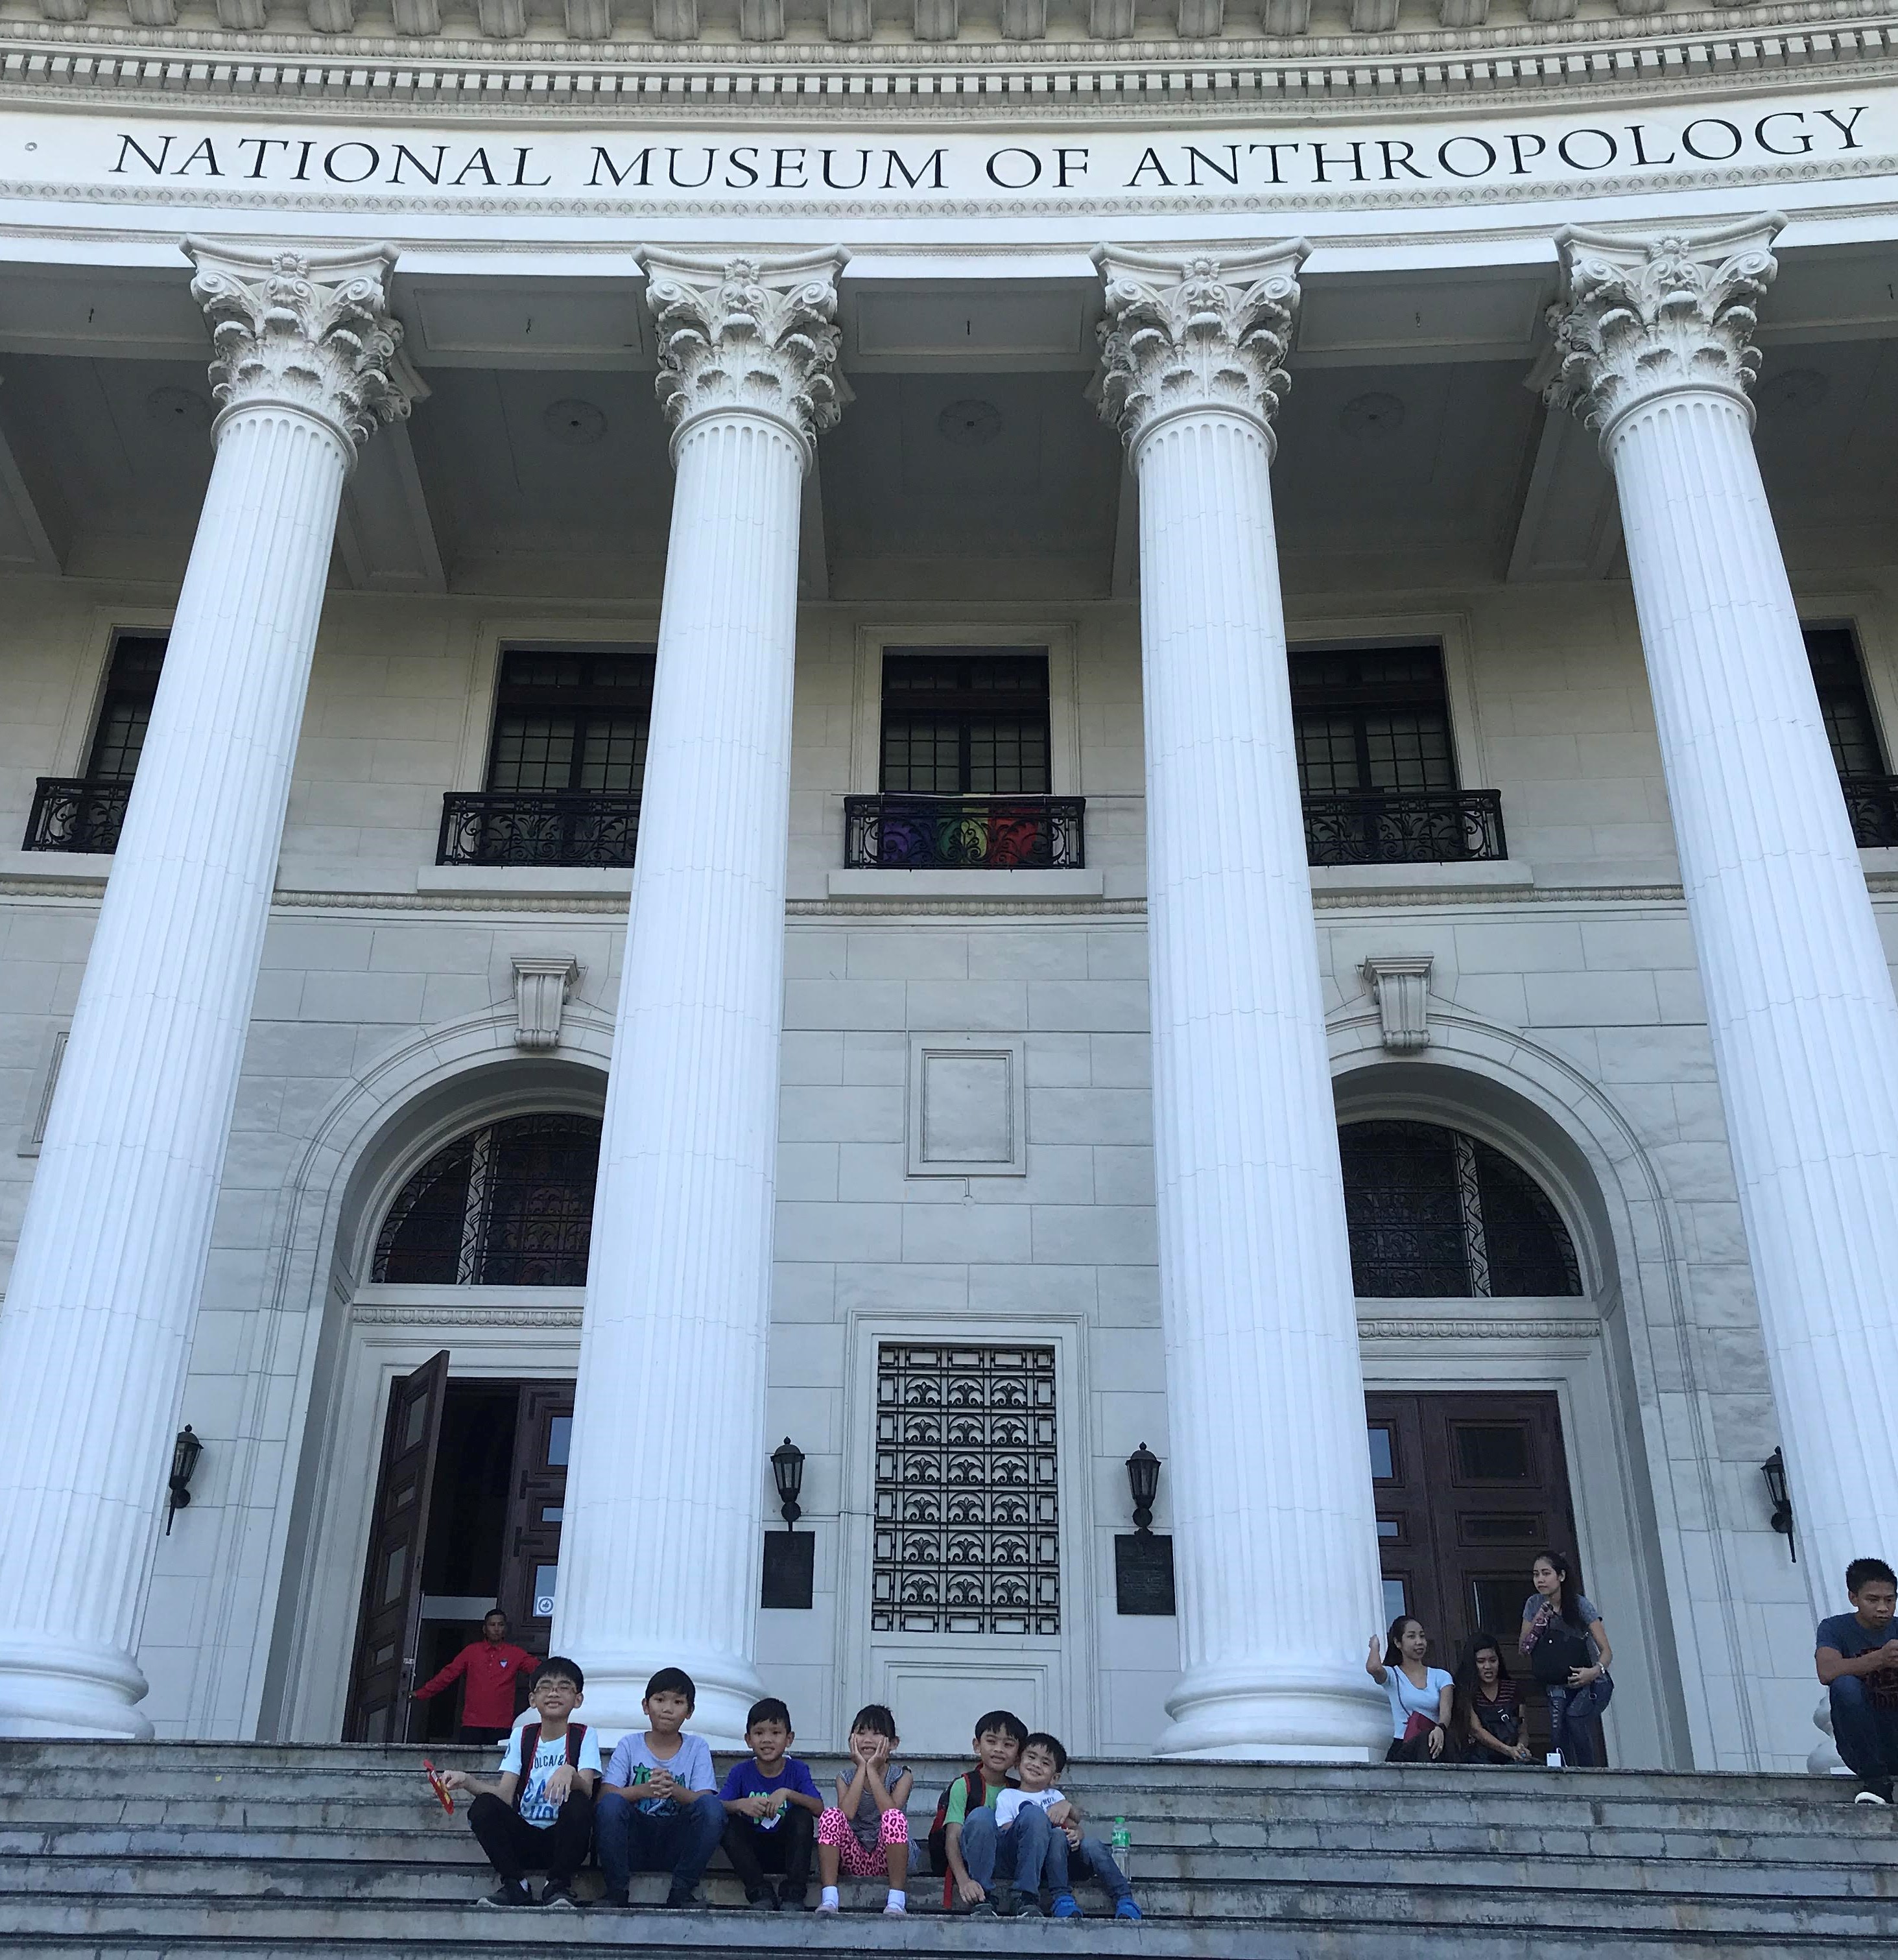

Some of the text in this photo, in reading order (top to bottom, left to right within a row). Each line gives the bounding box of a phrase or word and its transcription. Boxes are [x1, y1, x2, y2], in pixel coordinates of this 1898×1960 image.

[108, 106, 1869, 189] NATIONAL MUSEUM OF ANTHROPOLOGY
